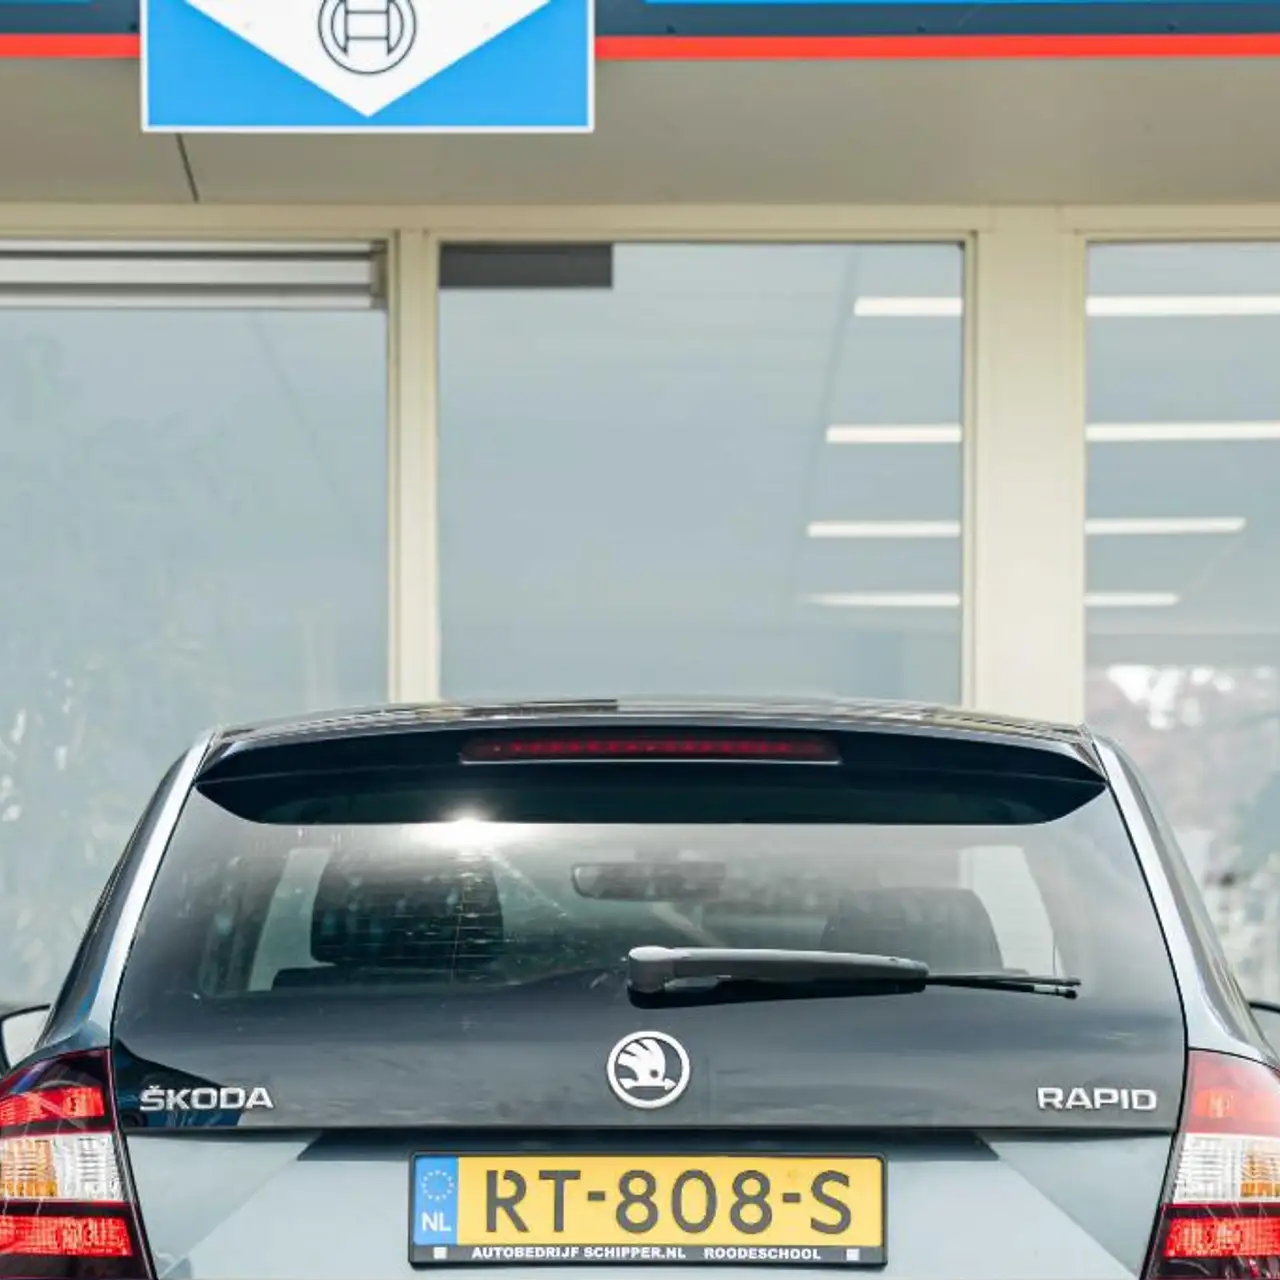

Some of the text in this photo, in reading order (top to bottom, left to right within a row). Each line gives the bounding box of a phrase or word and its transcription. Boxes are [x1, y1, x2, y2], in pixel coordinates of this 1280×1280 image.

[140, 1085, 274, 1111] ŠKODA
[1037, 1087, 1157, 1111] RAPID
[486, 1169, 852, 1234] RT-808-S
[421, 1212, 452, 1232] NL
[472, 1246, 821, 1261] AUTOBEDRIJF SCHIPPER.NL ROODESCHOOL
